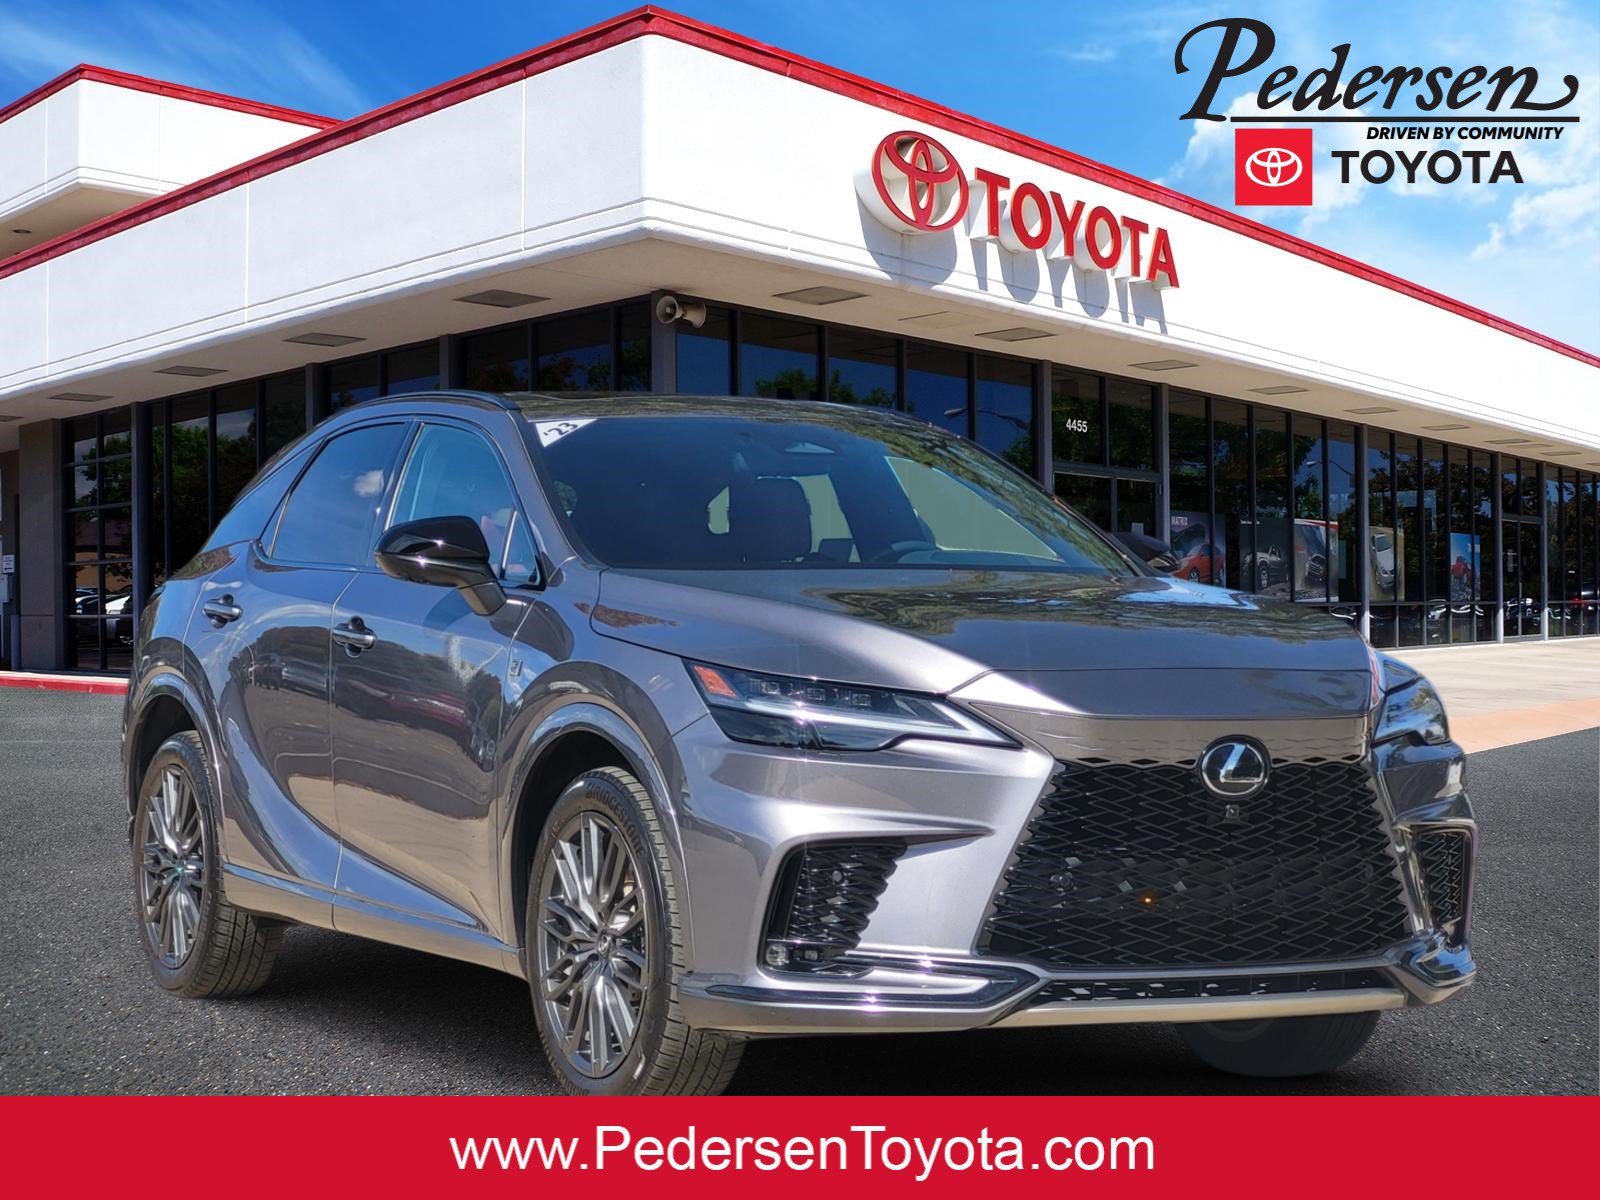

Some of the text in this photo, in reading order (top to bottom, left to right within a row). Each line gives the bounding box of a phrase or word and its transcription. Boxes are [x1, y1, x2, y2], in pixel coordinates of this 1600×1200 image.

[975, 167, 1180, 288] TOYOTA
[1066, 418, 1088, 432] 4455
[1171, 516, 1188, 526] MATRIX
